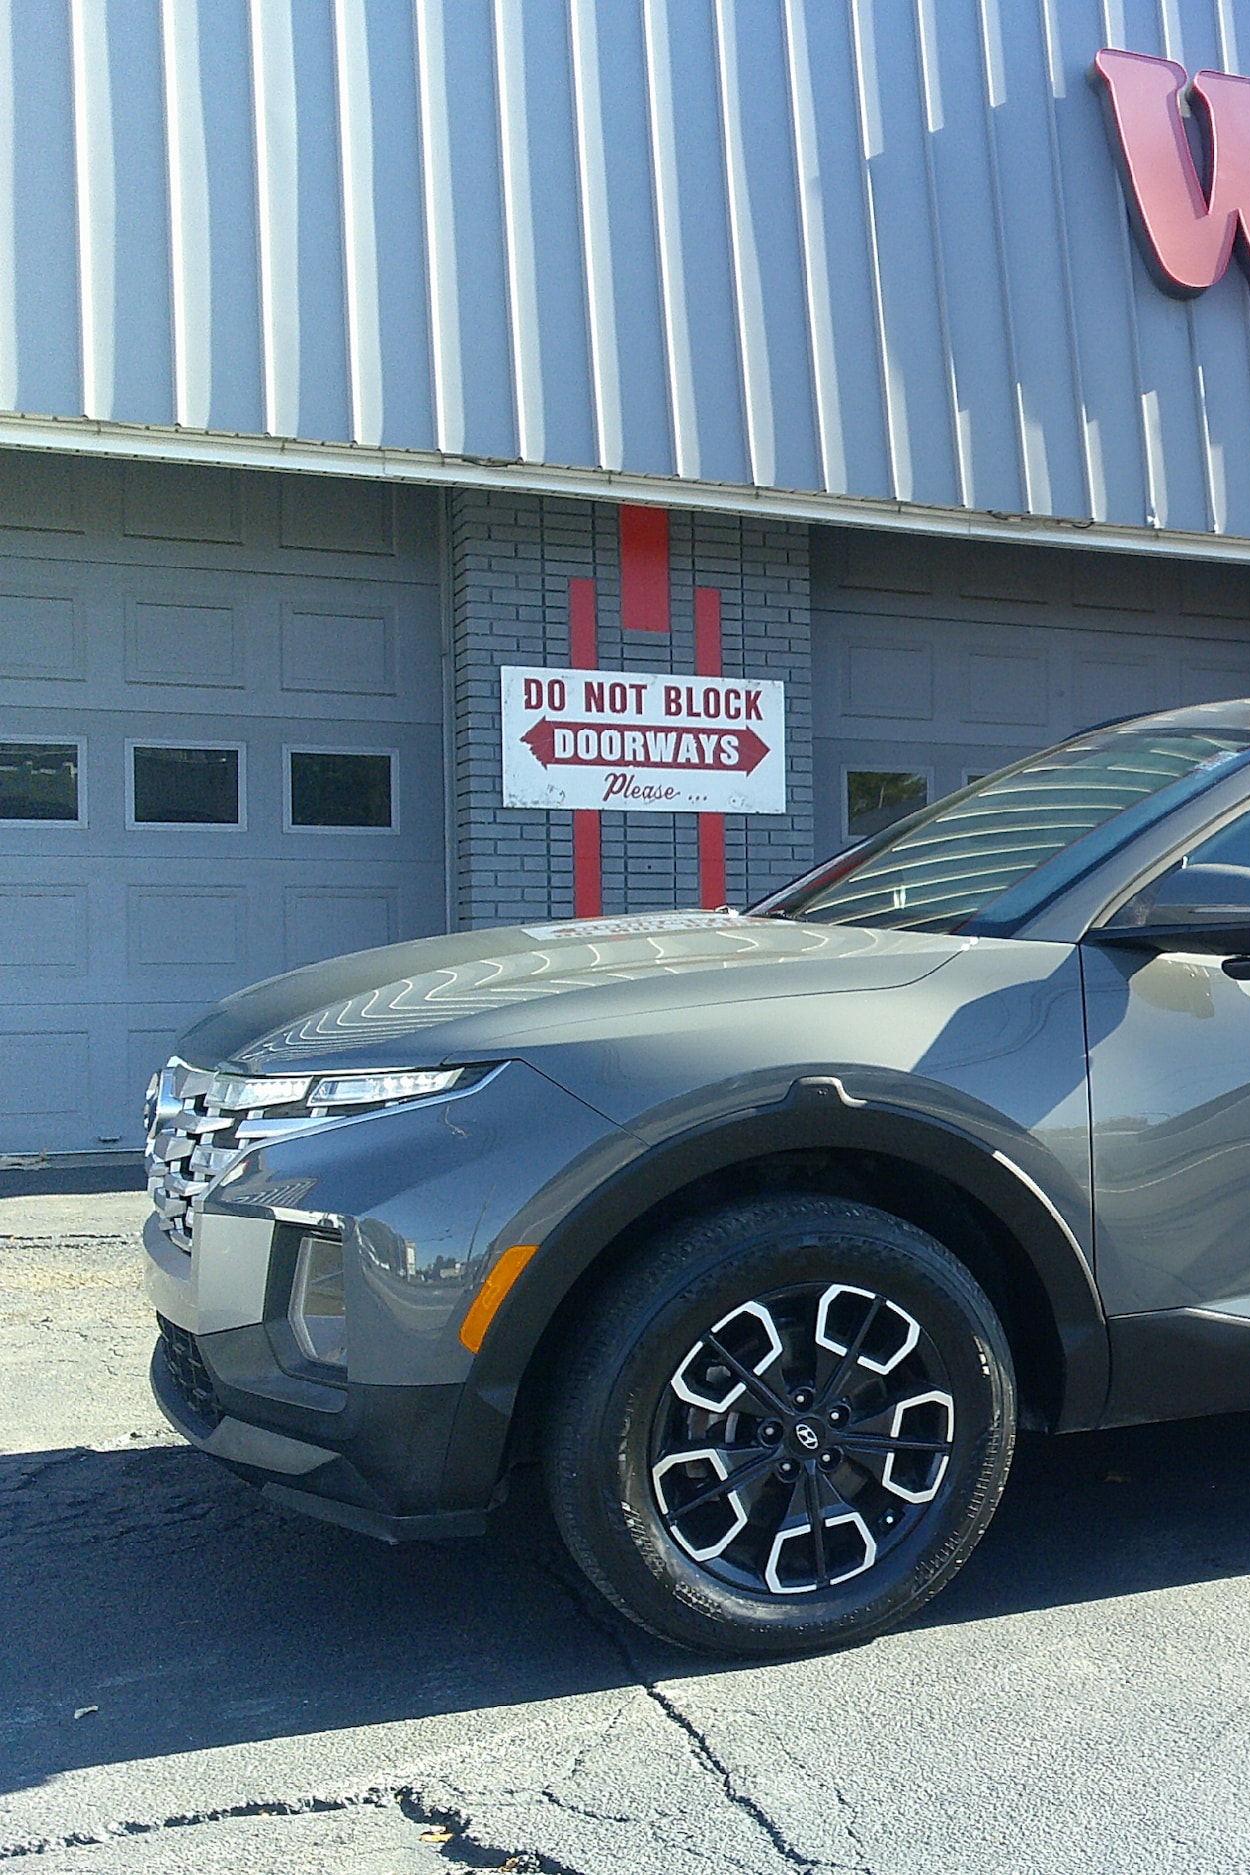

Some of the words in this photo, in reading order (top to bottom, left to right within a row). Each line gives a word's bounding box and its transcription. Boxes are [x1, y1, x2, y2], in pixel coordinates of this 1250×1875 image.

[524, 678, 565, 711] DO
[584, 681, 648, 715] NOT
[664, 686, 763, 721] BLOCK
[554, 728, 739, 765] DOORWAYS
